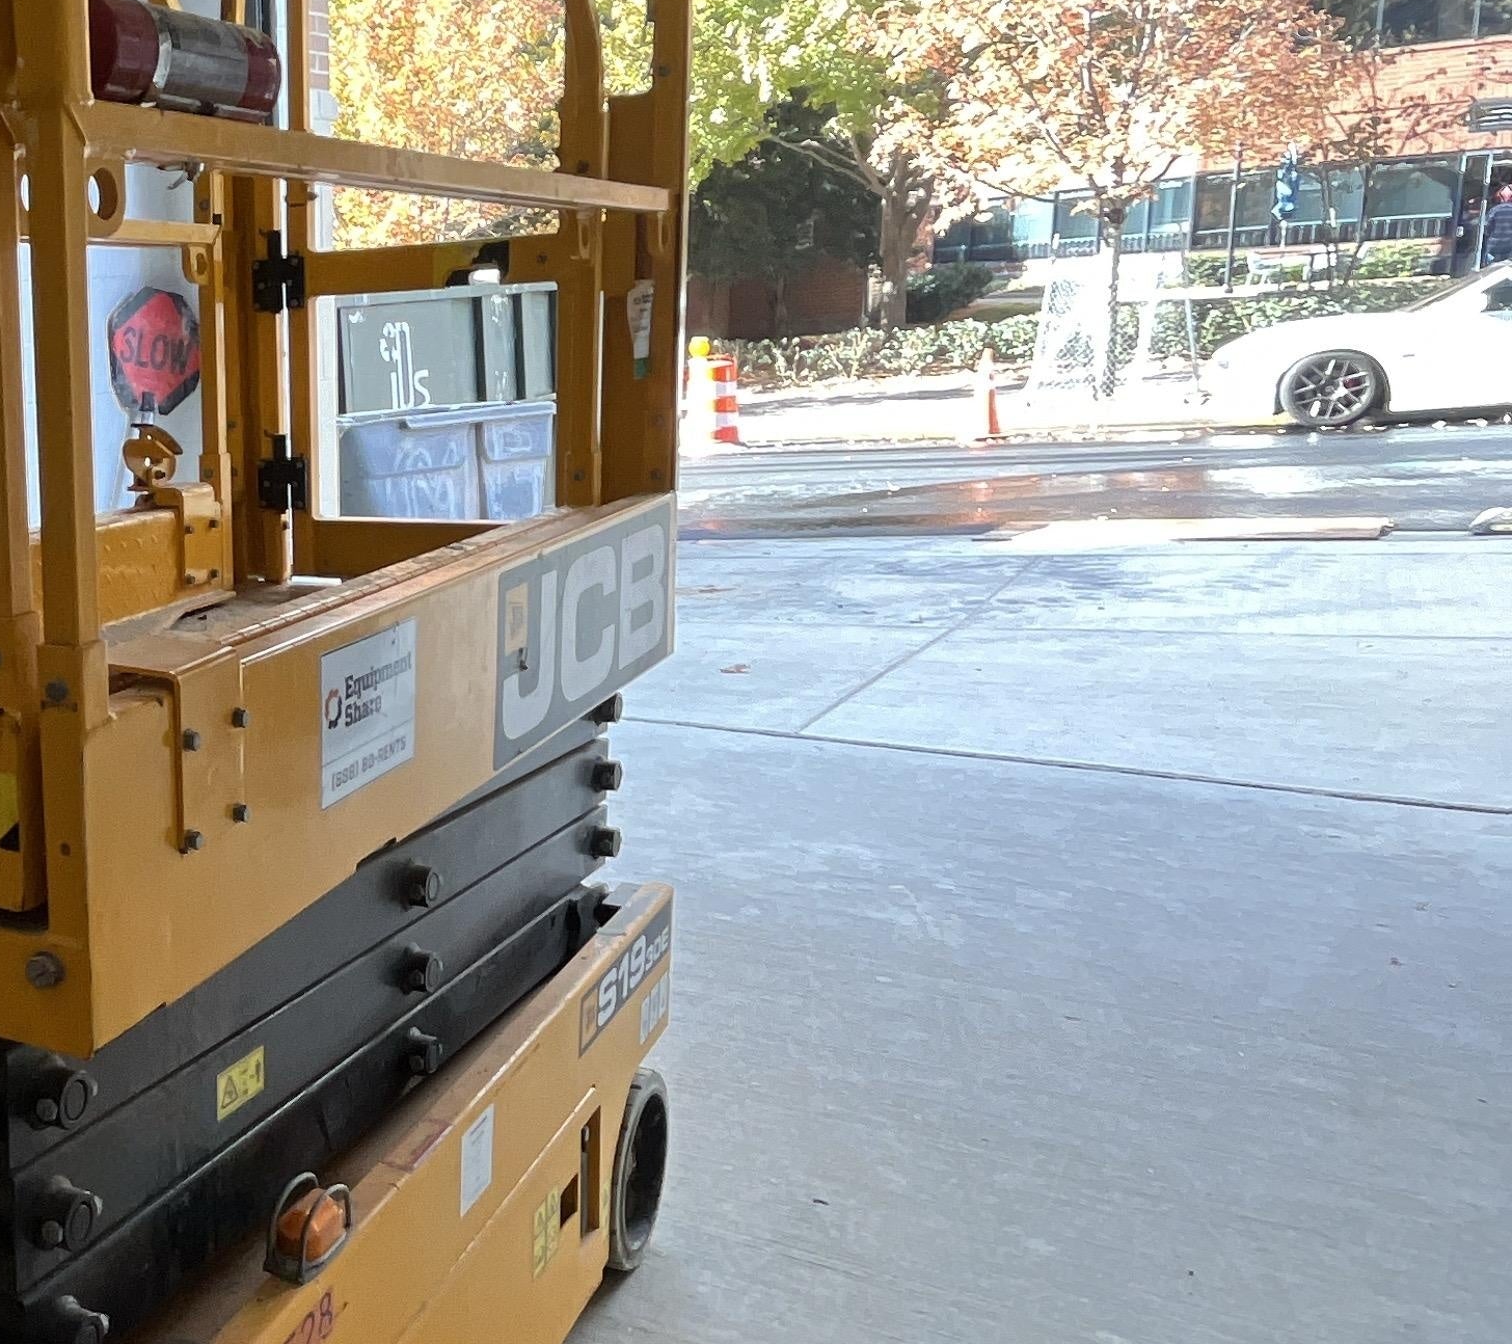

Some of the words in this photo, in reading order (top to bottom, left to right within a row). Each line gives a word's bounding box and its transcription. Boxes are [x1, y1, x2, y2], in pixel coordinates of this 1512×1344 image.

[120, 326, 190, 375] SLOW
[502, 524, 666, 740] JCB
[344, 652, 412, 700] Equipment
[344, 694, 382, 728] Share
